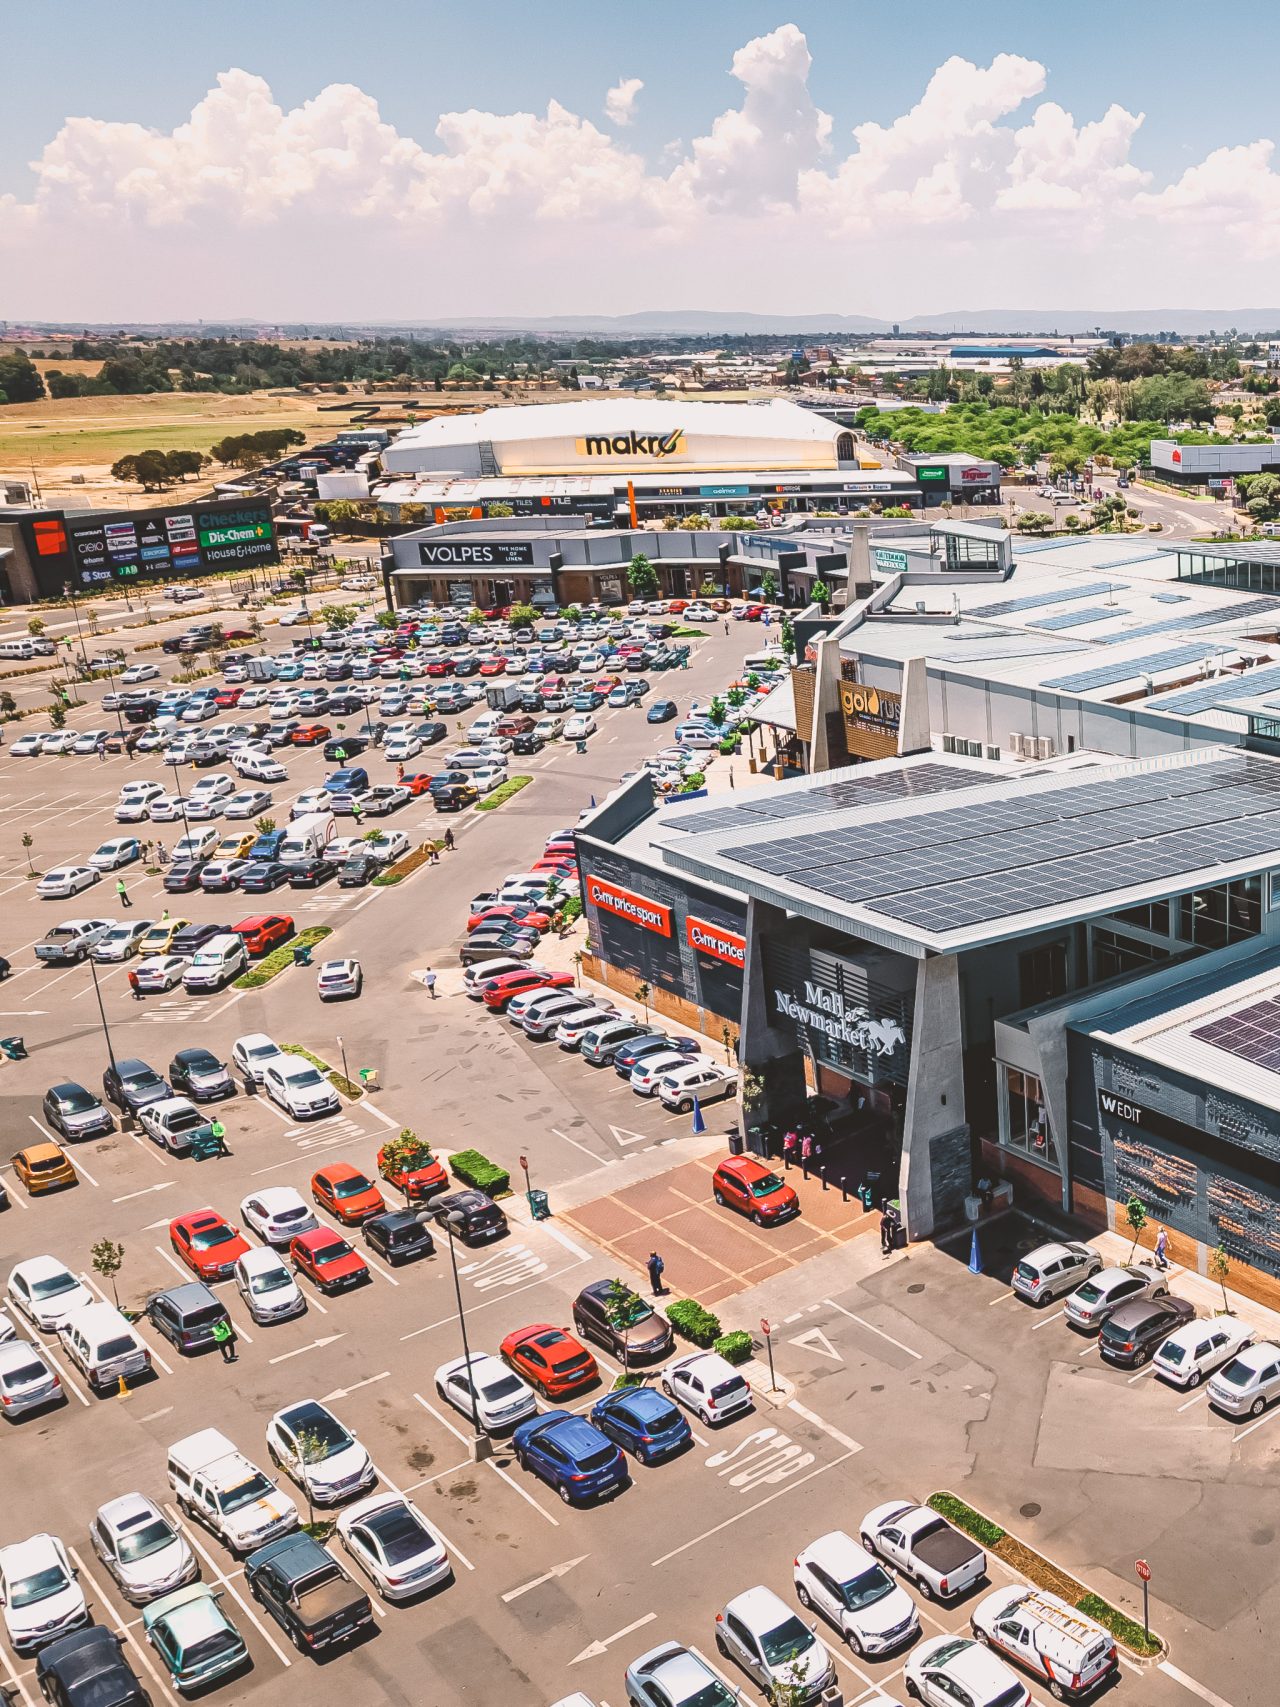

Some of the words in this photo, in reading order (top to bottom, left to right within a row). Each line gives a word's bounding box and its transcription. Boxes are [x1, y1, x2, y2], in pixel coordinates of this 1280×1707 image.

[586, 430, 683, 457] makro
[199, 510, 268, 527] Checkers
[208, 529, 255, 543] Dis-Chem
[424, 547, 493, 562] VOLPES
[92, 571, 111, 580] Stax
[842, 685, 900, 719] goldrus
[602, 892, 613, 905] mr
[614, 897, 636, 916] price
[637, 907, 662, 926] sport
[702, 934, 717, 949] mr
[717, 939, 743, 960] price
[804, 981, 844, 1018] Mall
[775, 989, 868, 1050] Newmarket
[457, 1244, 548, 1292] STOP
[704, 1427, 815, 1494] STOP
[1136, 1563, 1149, 1577] STOP
